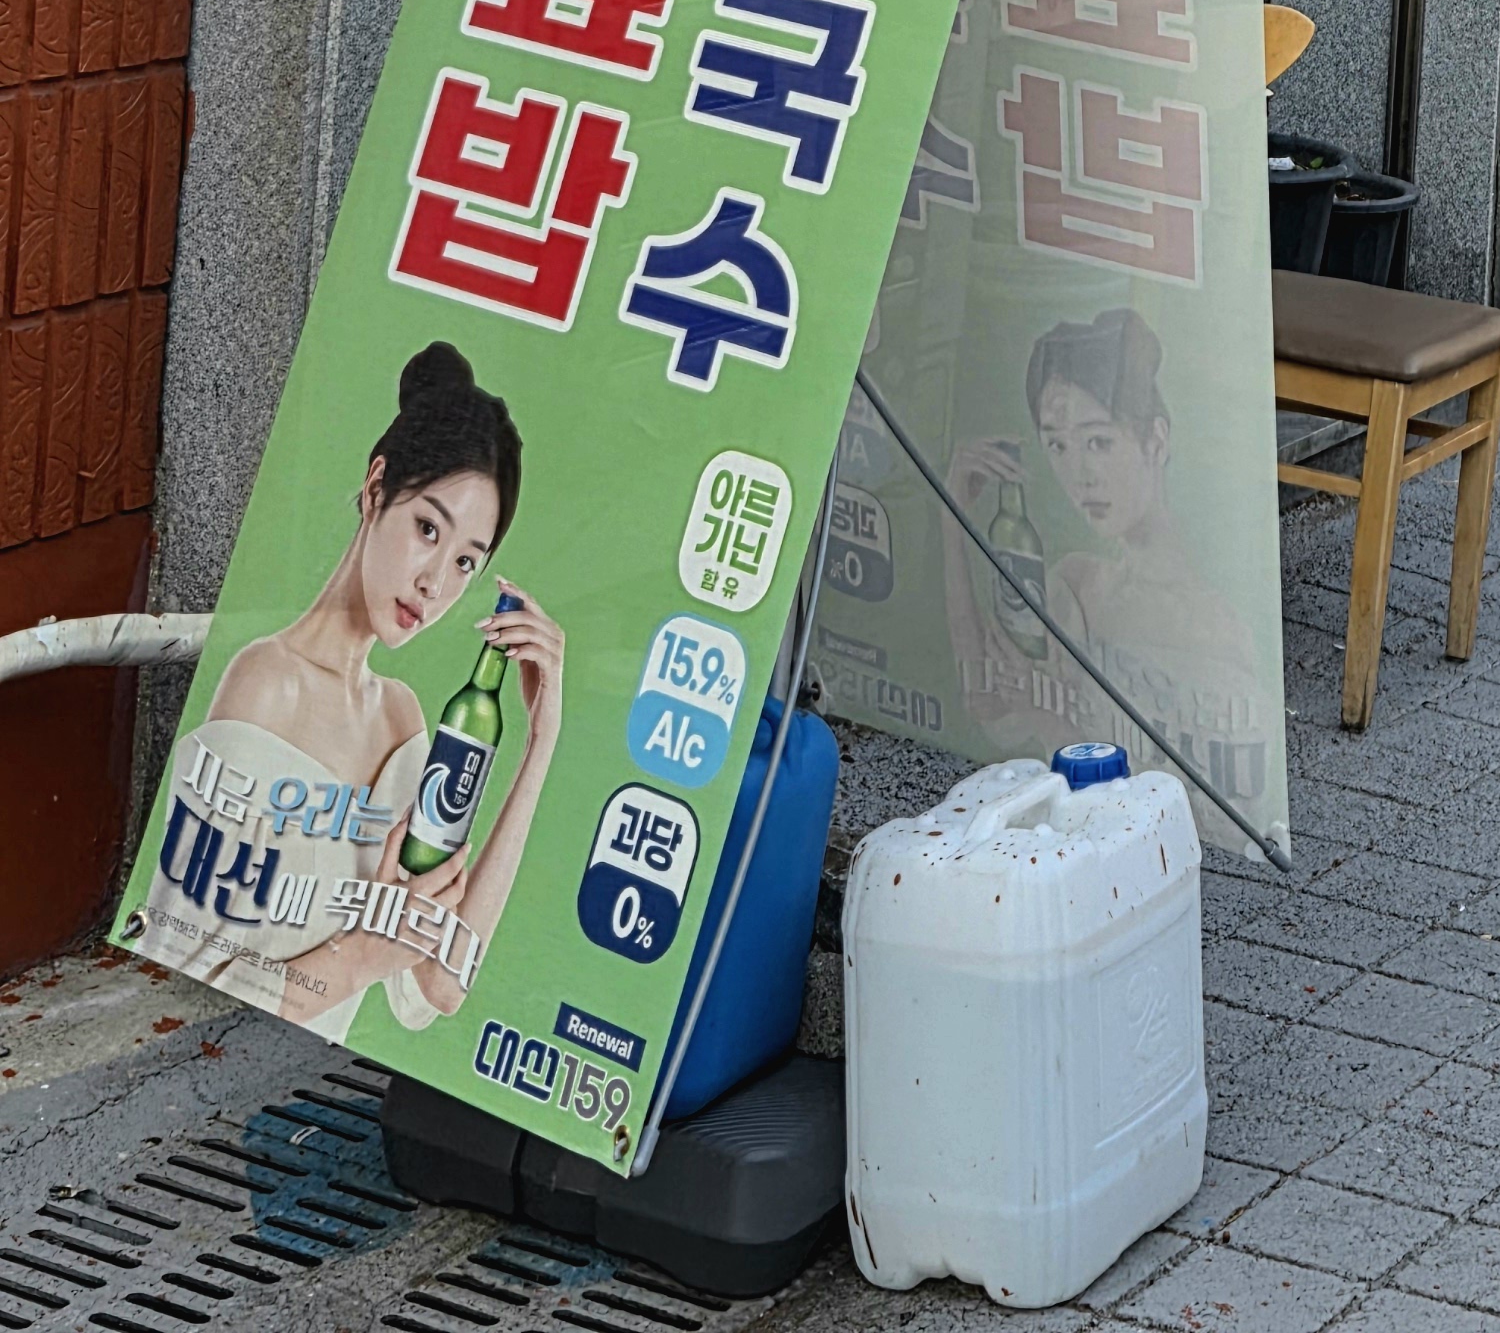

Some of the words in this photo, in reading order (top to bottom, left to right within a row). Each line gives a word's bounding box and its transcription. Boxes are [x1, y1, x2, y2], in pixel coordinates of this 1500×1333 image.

[710, 469, 780, 528] 아르
[694, 513, 768, 576] 기닌
[658, 630, 738, 706] 15.9%
[644, 709, 706, 769] Alc
[182, 735, 257, 823] 지금
[262, 776, 394, 845] 우리는
[610, 802, 684, 873] 과당
[160, 794, 318, 925] 대선에
[325, 878, 482, 992] 목마르다
[611, 886, 656, 950] 0%
[567, 1012, 633, 1061] Renewal
